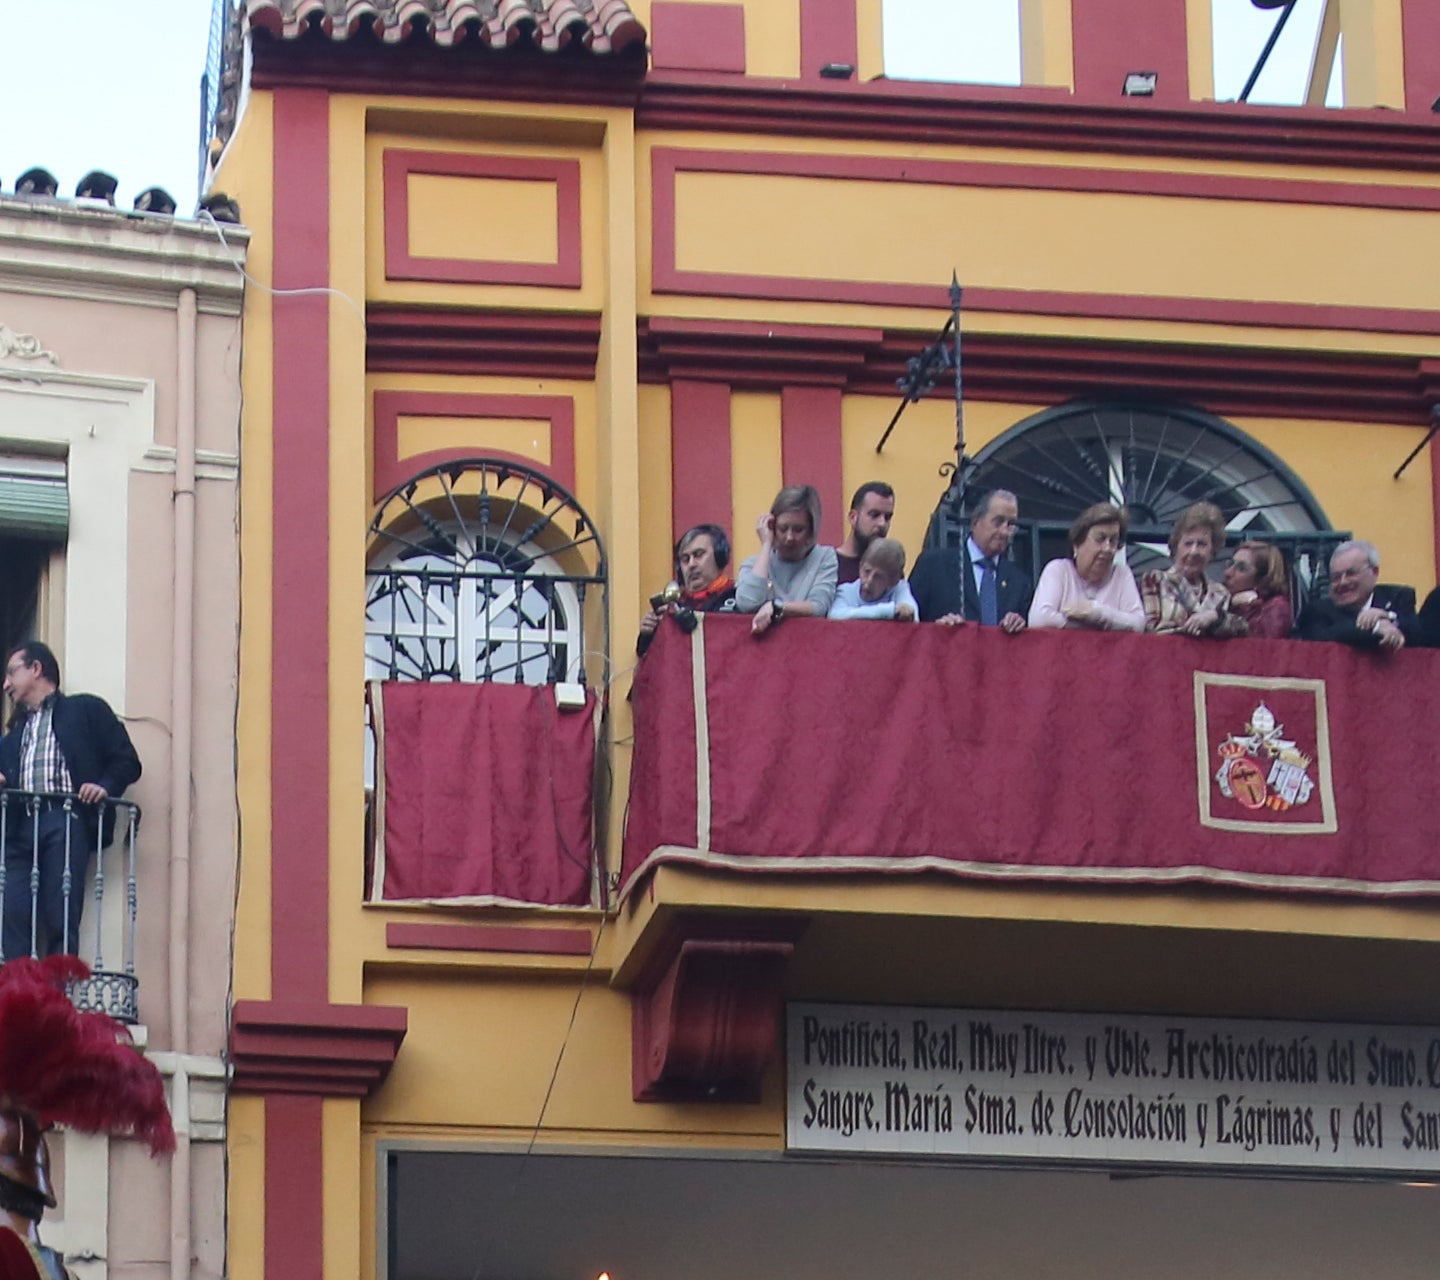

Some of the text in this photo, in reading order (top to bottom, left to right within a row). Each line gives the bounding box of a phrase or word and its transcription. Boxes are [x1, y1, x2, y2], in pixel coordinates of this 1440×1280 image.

[802, 1015, 907, 1071] Pontificia,
[912, 1019, 963, 1073] Real,
[969, 1020, 1018, 1078] Muy
[1023, 1023, 1074, 1075] Iltre.
[1085, 1035, 1096, 1080] y
[1162, 1028, 1317, 1083] Archicofradía
[1327, 1038, 1354, 1085] del
[1367, 1035, 1423, 1088] Stmo.
[803, 1077, 880, 1136] Sangre,
[885, 1080, 952, 1132] María
[964, 1083, 1024, 1135] Stma.
[1031, 1087, 1054, 1136] de
[1064, 1087, 1186, 1142] Consolación
[1197, 1102, 1208, 1148] y
[1216, 1094, 1320, 1152] Lágrimas,
[1330, 1107, 1340, 1152] y
[1353, 1102, 1382, 1149] del
